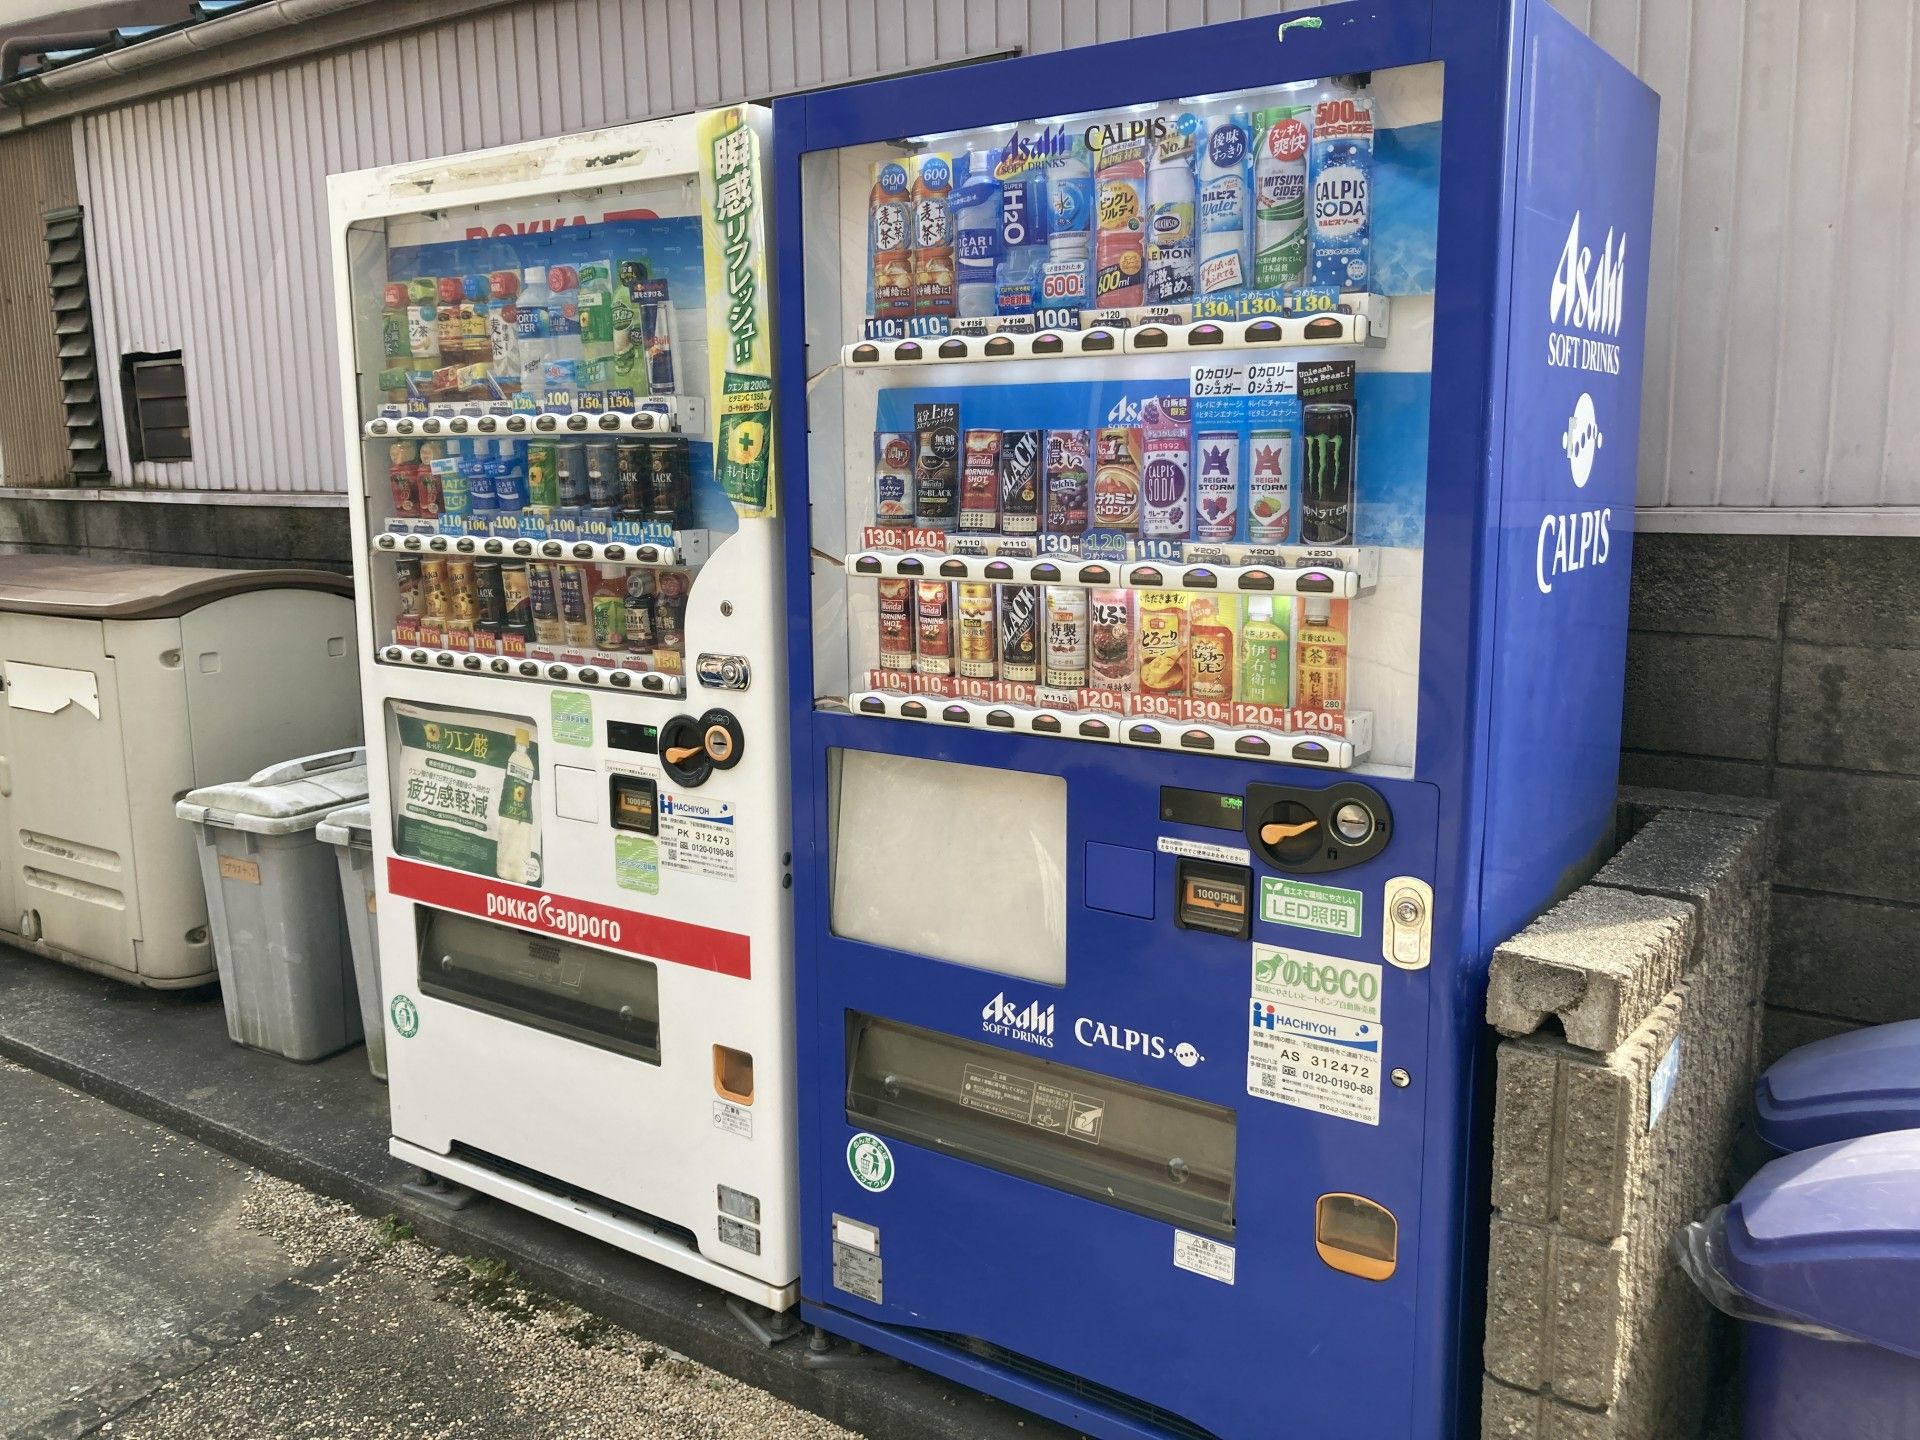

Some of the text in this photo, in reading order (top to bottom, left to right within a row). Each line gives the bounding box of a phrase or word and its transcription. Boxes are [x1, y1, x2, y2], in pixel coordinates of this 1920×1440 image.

[1315, 100, 1371, 126] 500ml
[1084, 116, 1167, 151] CALPIS
[1213, 128, 1240, 149] 後味
[1273, 122, 1302, 140] スッキリ
[1001, 124, 1065, 161] Asahi
[1273, 134, 1306, 157] 爽快
[1212, 143, 1244, 162] すっきり
[924, 168, 947, 181] 600
[1001, 158, 1066, 175] SOFT DRINKS
[882, 173, 905, 185] 600
[1264, 174, 1304, 187] MITSUYA
[1273, 185, 1304, 197] CIDER
[1316, 180, 1366, 201] CALPIS
[1055, 191, 1074, 216] 水
[1203, 201, 1237, 217] Water
[1315, 201, 1365, 218] SODA
[878, 206, 895, 248] 麦茶
[893, 207, 904, 241] 十六茶
[920, 203, 937, 245] 麦茶
[935, 204, 947, 239] 十六茶
[714, 126, 757, 362] 瞬感リフレッシュ!!
[1148, 249, 1192, 261] LEMON
[1549, 209, 1627, 338] Asahi
[1043, 275, 1079, 296] 600
[911, 317, 948, 337] 110円
[1036, 309, 1078, 327] 100円
[867, 320, 902, 337] 110円
[1547, 331, 1621, 376] SOFT DRINKS
[1299, 365, 1333, 378] Unleash
[1304, 376, 1319, 384] the
[1170, 407, 1187, 416] 限定
[934, 434, 955, 446] 無糖
[1148, 464, 1175, 478] CALPIS
[1148, 478, 1176, 501] SODA
[867, 529, 902, 545] 130円
[907, 529, 944, 547] 140円
[1039, 535, 1079, 552] 130円
[1137, 540, 1180, 558] 110円
[1536, 507, 1611, 595] CALPIS
[1051, 622, 1077, 637] 特製
[1049, 636, 1081, 646] カフェオレ
[1308, 648, 1325, 664] 茶
[1197, 662, 1225, 674] レモン
[1251, 644, 1267, 700] 伊右衛門
[873, 671, 907, 689] 110円
[913, 675, 948, 692] 110円
[953, 679, 988, 697] 110円
[995, 681, 1032, 702] 110円
[1080, 690, 1121, 709] 120円
[1133, 695, 1177, 714] 130円
[1184, 701, 1229, 720] 130円
[1236, 704, 1281, 726] 120円
[1294, 710, 1343, 732] 120円
[444, 728, 489, 759] クエン酸
[407, 777, 489, 819] 疲労感軽減
[674, 802, 710, 815] HACHIYOH
[677, 828, 730, 846] PK 312473
[691, 843, 734, 858] 0120-0190-88
[1197, 888, 1238, 904] 1000円札
[1273, 899, 1348, 928] LED照明
[982, 991, 1054, 1036] Asahi
[982, 1021, 1054, 1048] SOFT DRINKS
[1276, 1014, 1337, 1036] HACHIYOH
[1074, 1017, 1165, 1059] CALPIS
[1281, 1049, 1369, 1078] AS 312472
[1302, 1070, 1374, 1096] 0120-0190-88
[1202, 1240, 1217, 1253] 警告
